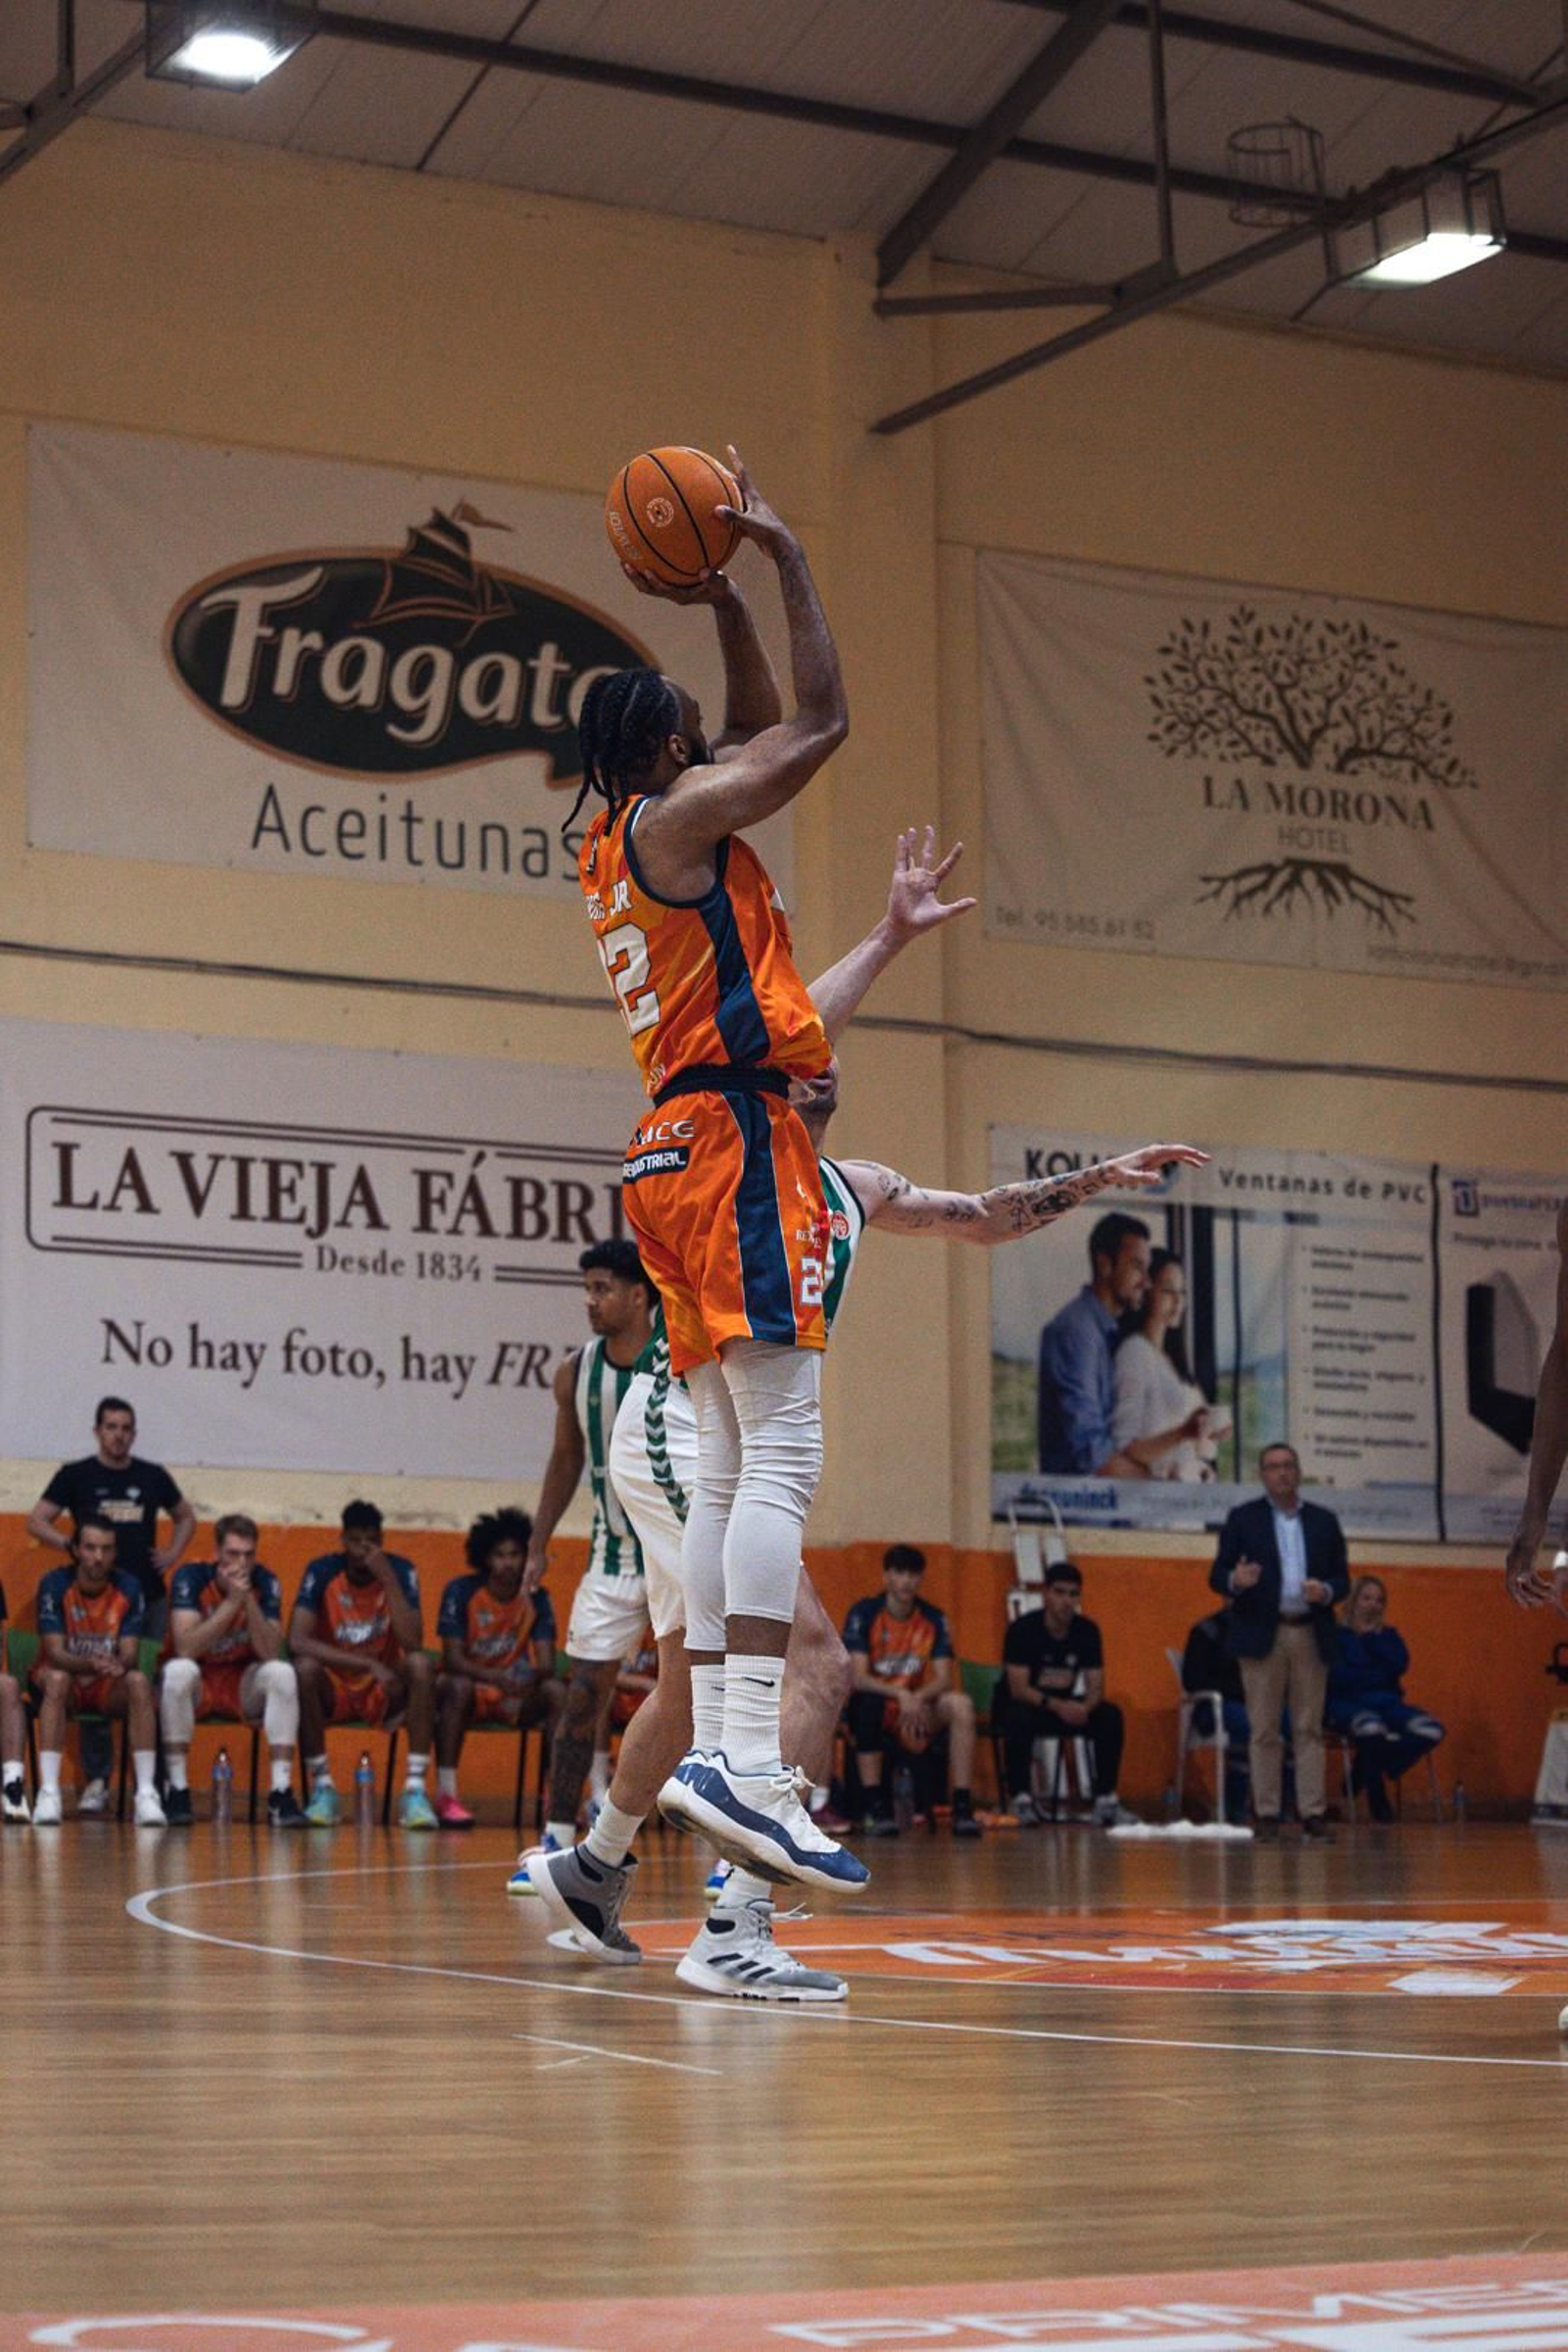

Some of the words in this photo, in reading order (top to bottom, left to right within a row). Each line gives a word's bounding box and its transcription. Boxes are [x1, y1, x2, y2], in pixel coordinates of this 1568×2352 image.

[1203, 774, 1250, 811] LA
[1265, 781, 1435, 831] MORONA
[1278, 825, 1351, 855] HOTEL
[610, 879, 634, 917] JR
[597, 922, 662, 1037] 2
[51, 1141, 161, 1215] LA
[169, 1150, 389, 1240] VIEJA
[412, 1150, 627, 1246] FÁBRI
[1219, 1168, 1334, 1197] Ventanas
[1343, 1178, 1372, 1200] de
[1381, 1181, 1427, 1205] PVC
[316, 1245, 406, 1278] Desde
[416, 1250, 482, 1282] 1834
[101, 1318, 174, 1369] No
[188, 1322, 268, 1389] hay
[281, 1328, 386, 1389] foto,
[401, 1334, 477, 1401] hay
[487, 1342, 578, 1390] FR
